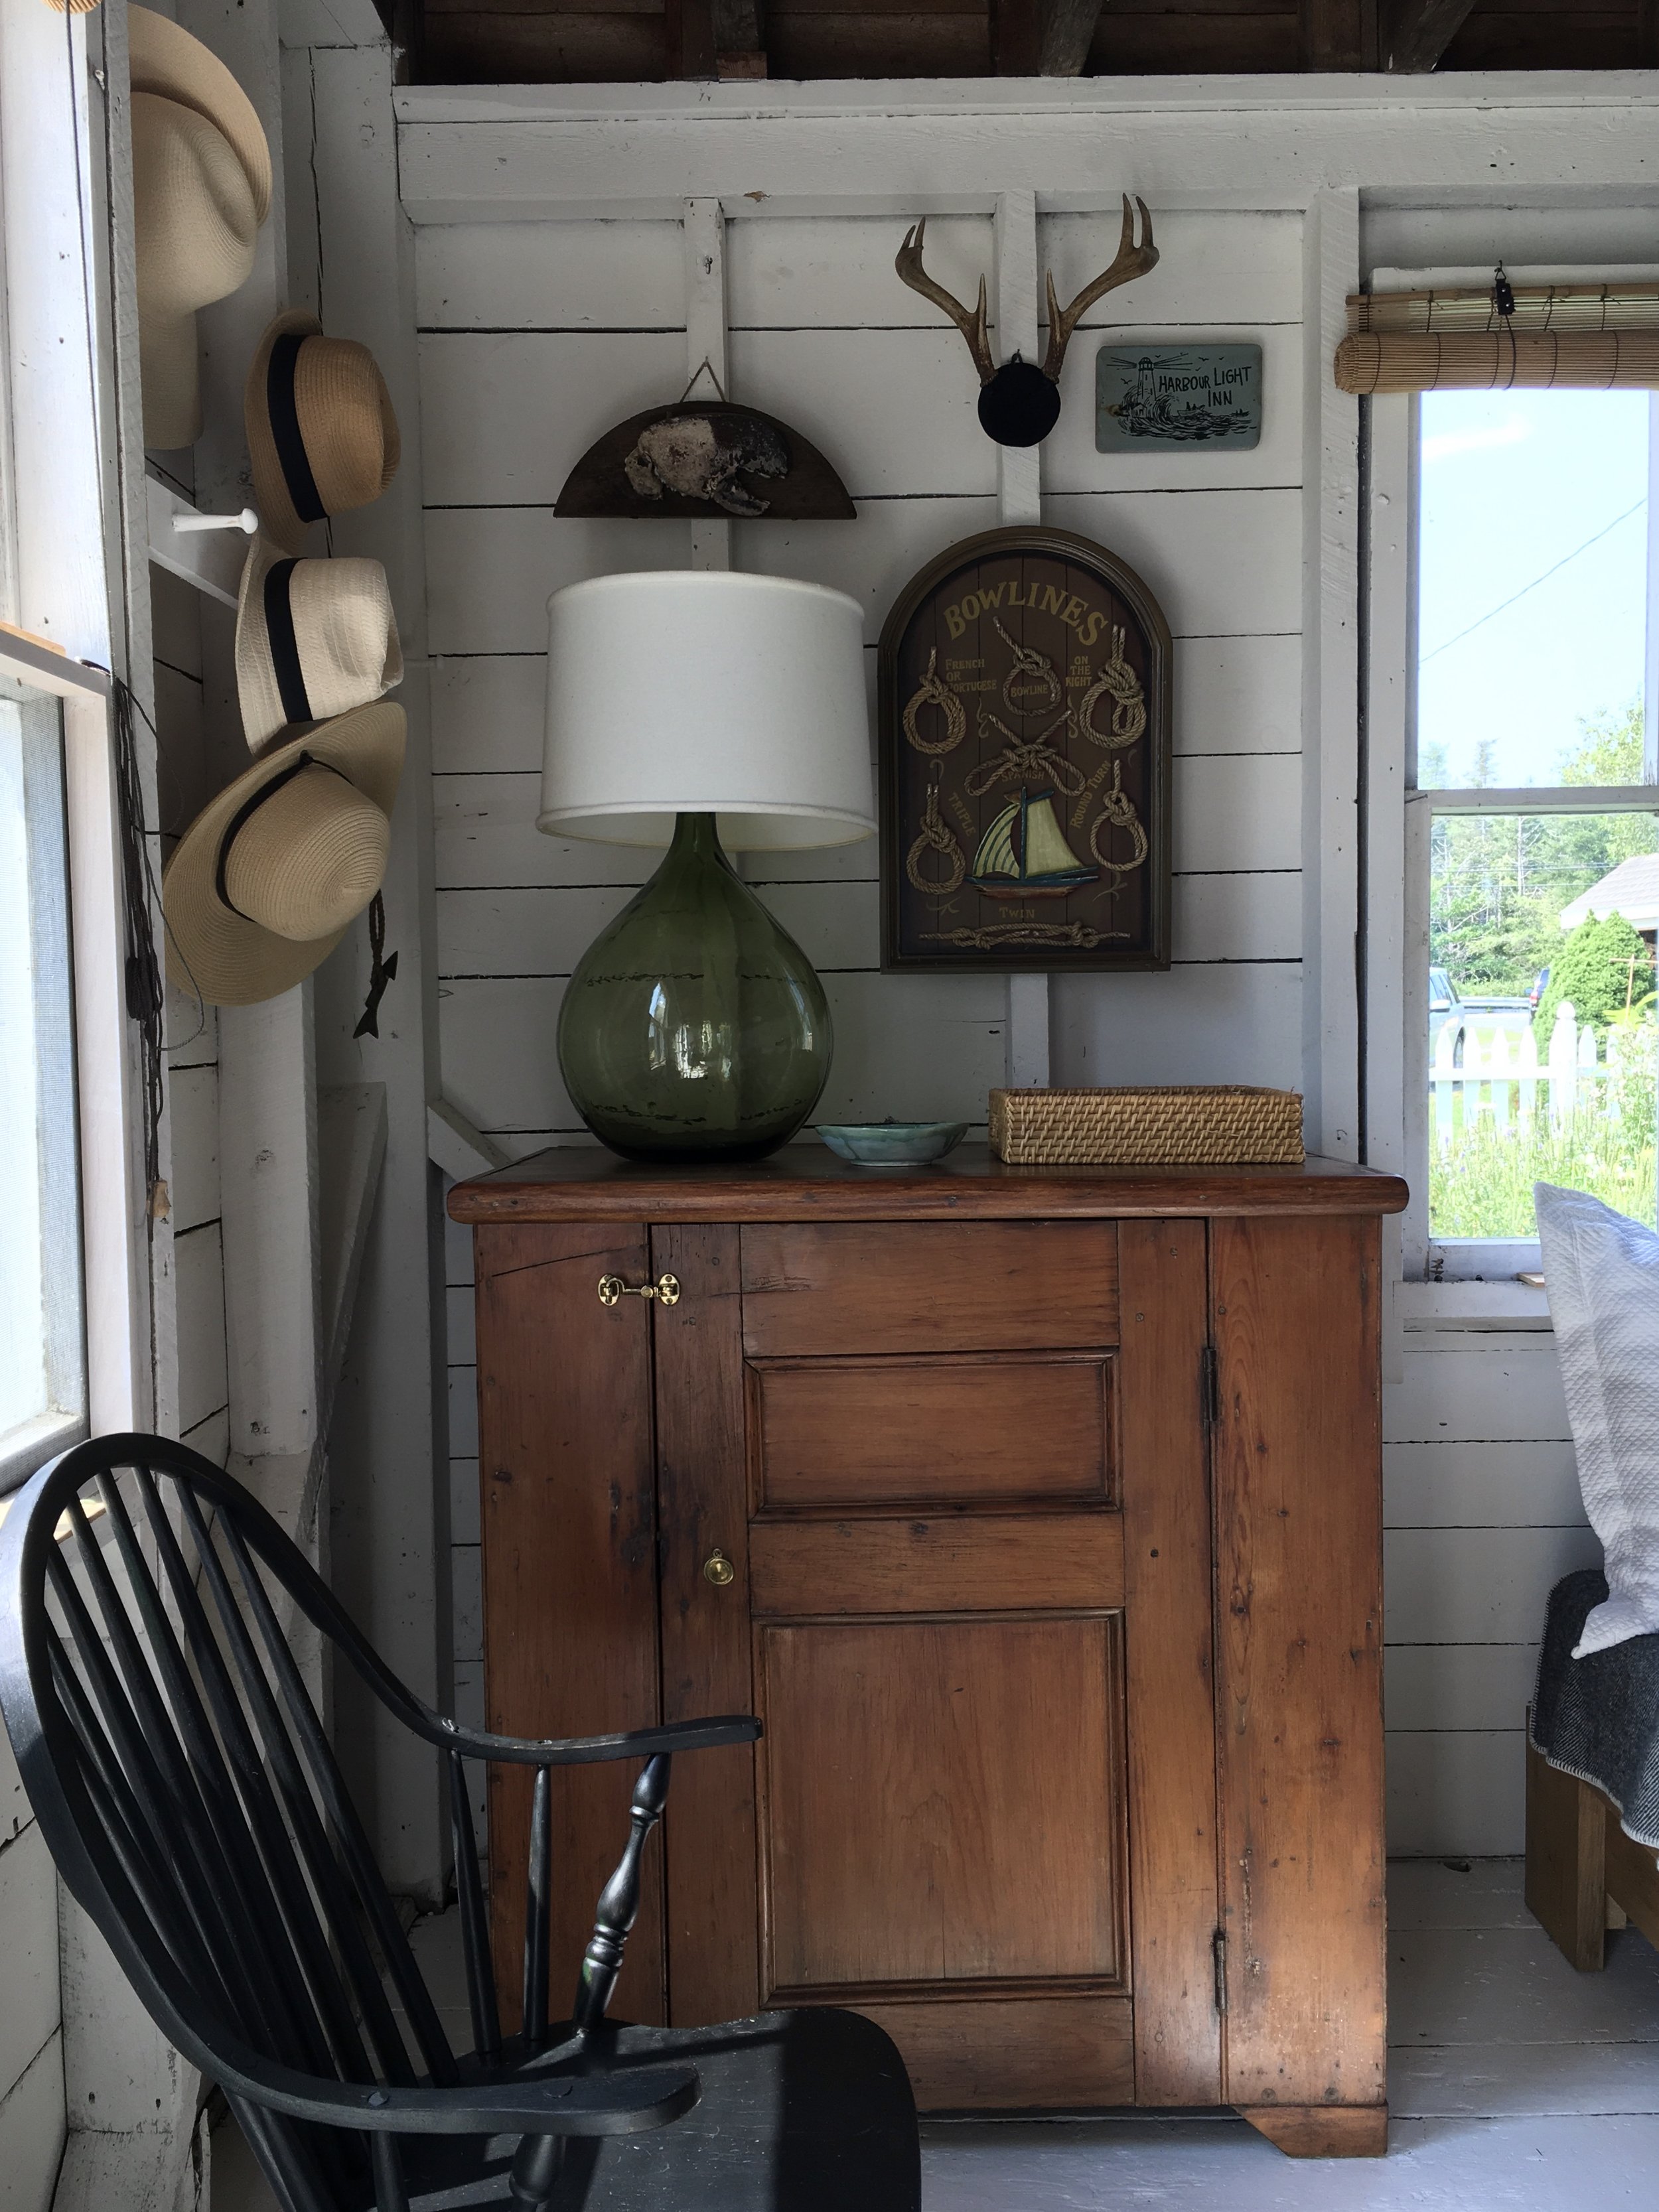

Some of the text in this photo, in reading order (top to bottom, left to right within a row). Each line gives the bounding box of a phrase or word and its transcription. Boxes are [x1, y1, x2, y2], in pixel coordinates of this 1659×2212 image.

[1159, 366, 1252, 393] HARBOUR LIGHT
[1208, 390, 1232, 407] INN
[943, 581, 1109, 646] BOWLINES
[945, 658, 985, 670] FRENCH
[1074, 656, 1088, 665] ON
[946, 671, 961, 682] OR
[1070, 665, 1091, 675] THE
[1065, 676, 1092, 687] RIGHT
[1011, 684, 1048, 698] BOWLINE
[1001, 769, 1045, 782] SPANISH
[1070, 760, 1112, 829] ROUND TURN
[948, 792, 976, 837] TRIPLE
[999, 906, 1035, 918] TWIN
